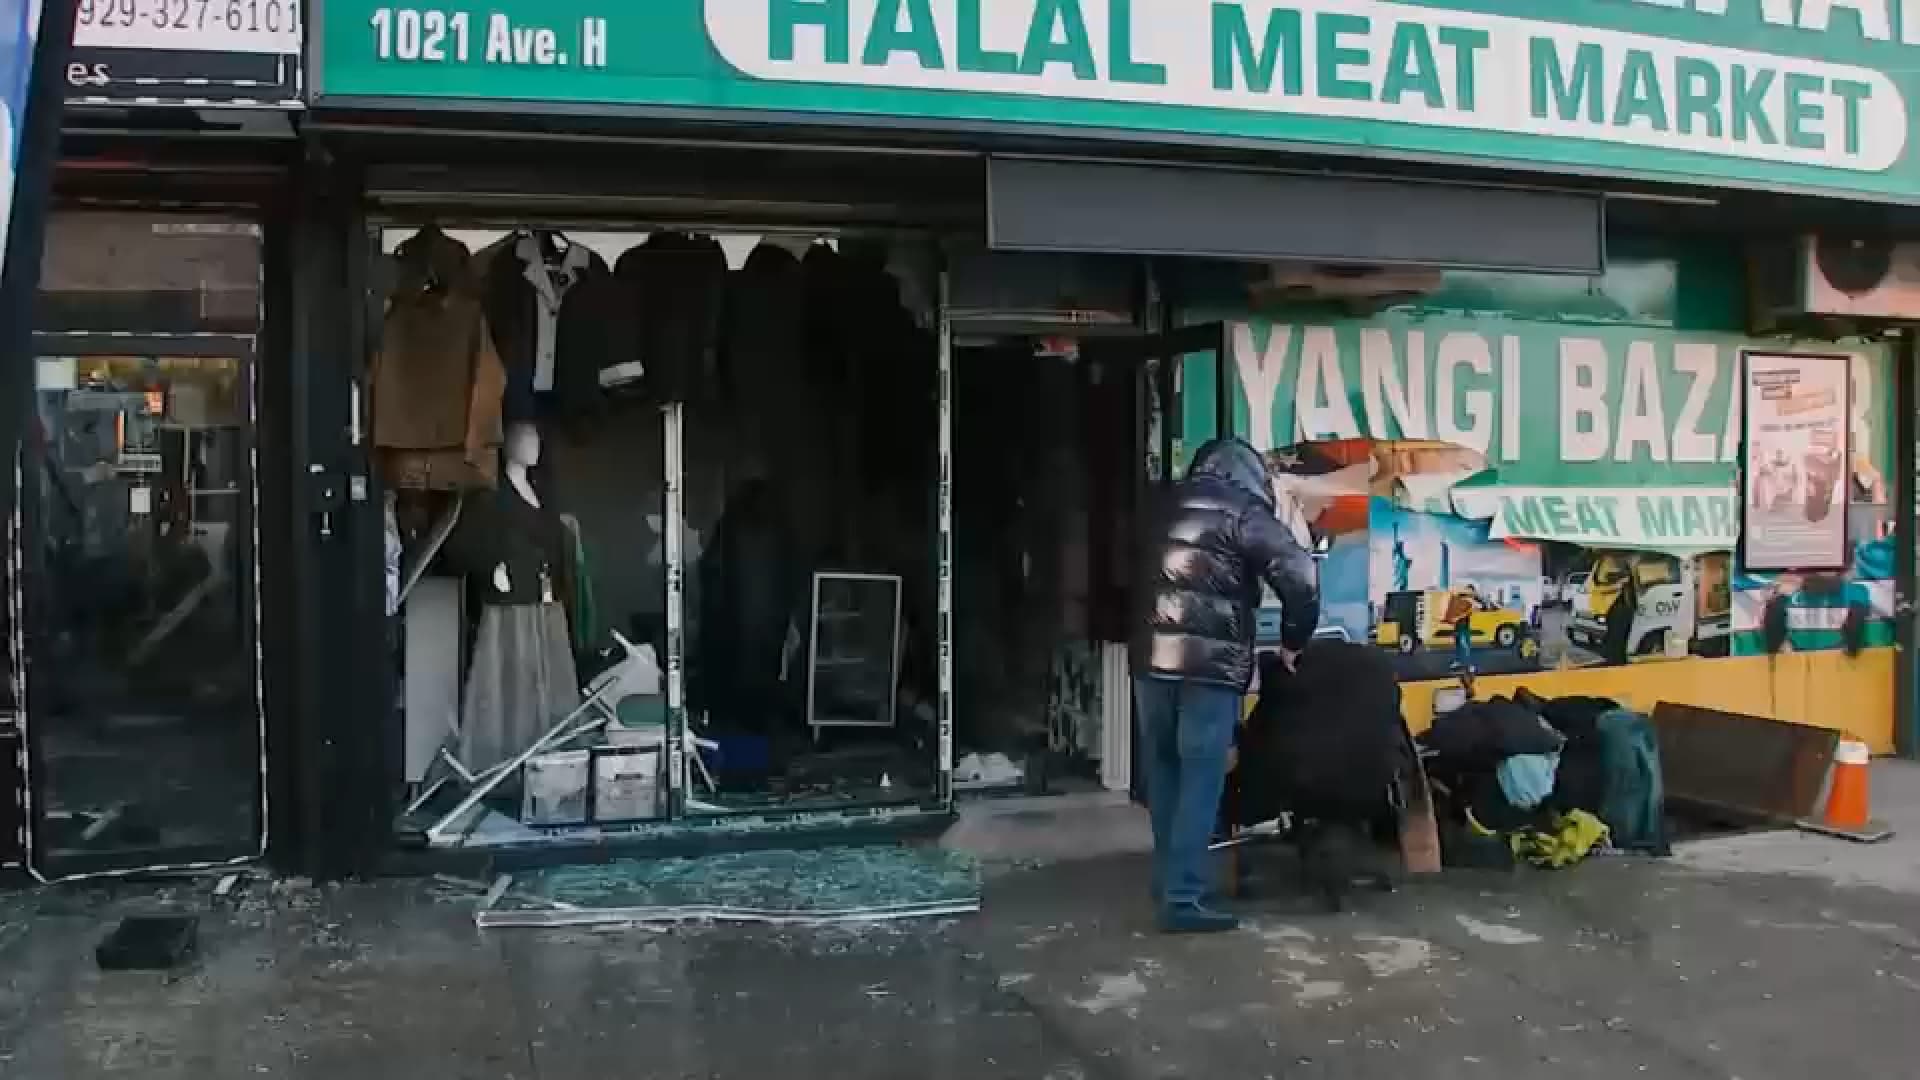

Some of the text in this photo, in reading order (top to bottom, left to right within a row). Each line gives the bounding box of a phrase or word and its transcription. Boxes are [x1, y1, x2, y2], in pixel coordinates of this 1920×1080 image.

[369, 7, 607, 67] 1021 Ave. H
[767, 0, 1872, 155] HALAL MEAT MARKET
[1233, 322, 1521, 462] YANGI
[1502, 495, 1620, 536] MEAT
[1637, 495, 1741, 537] MAR
